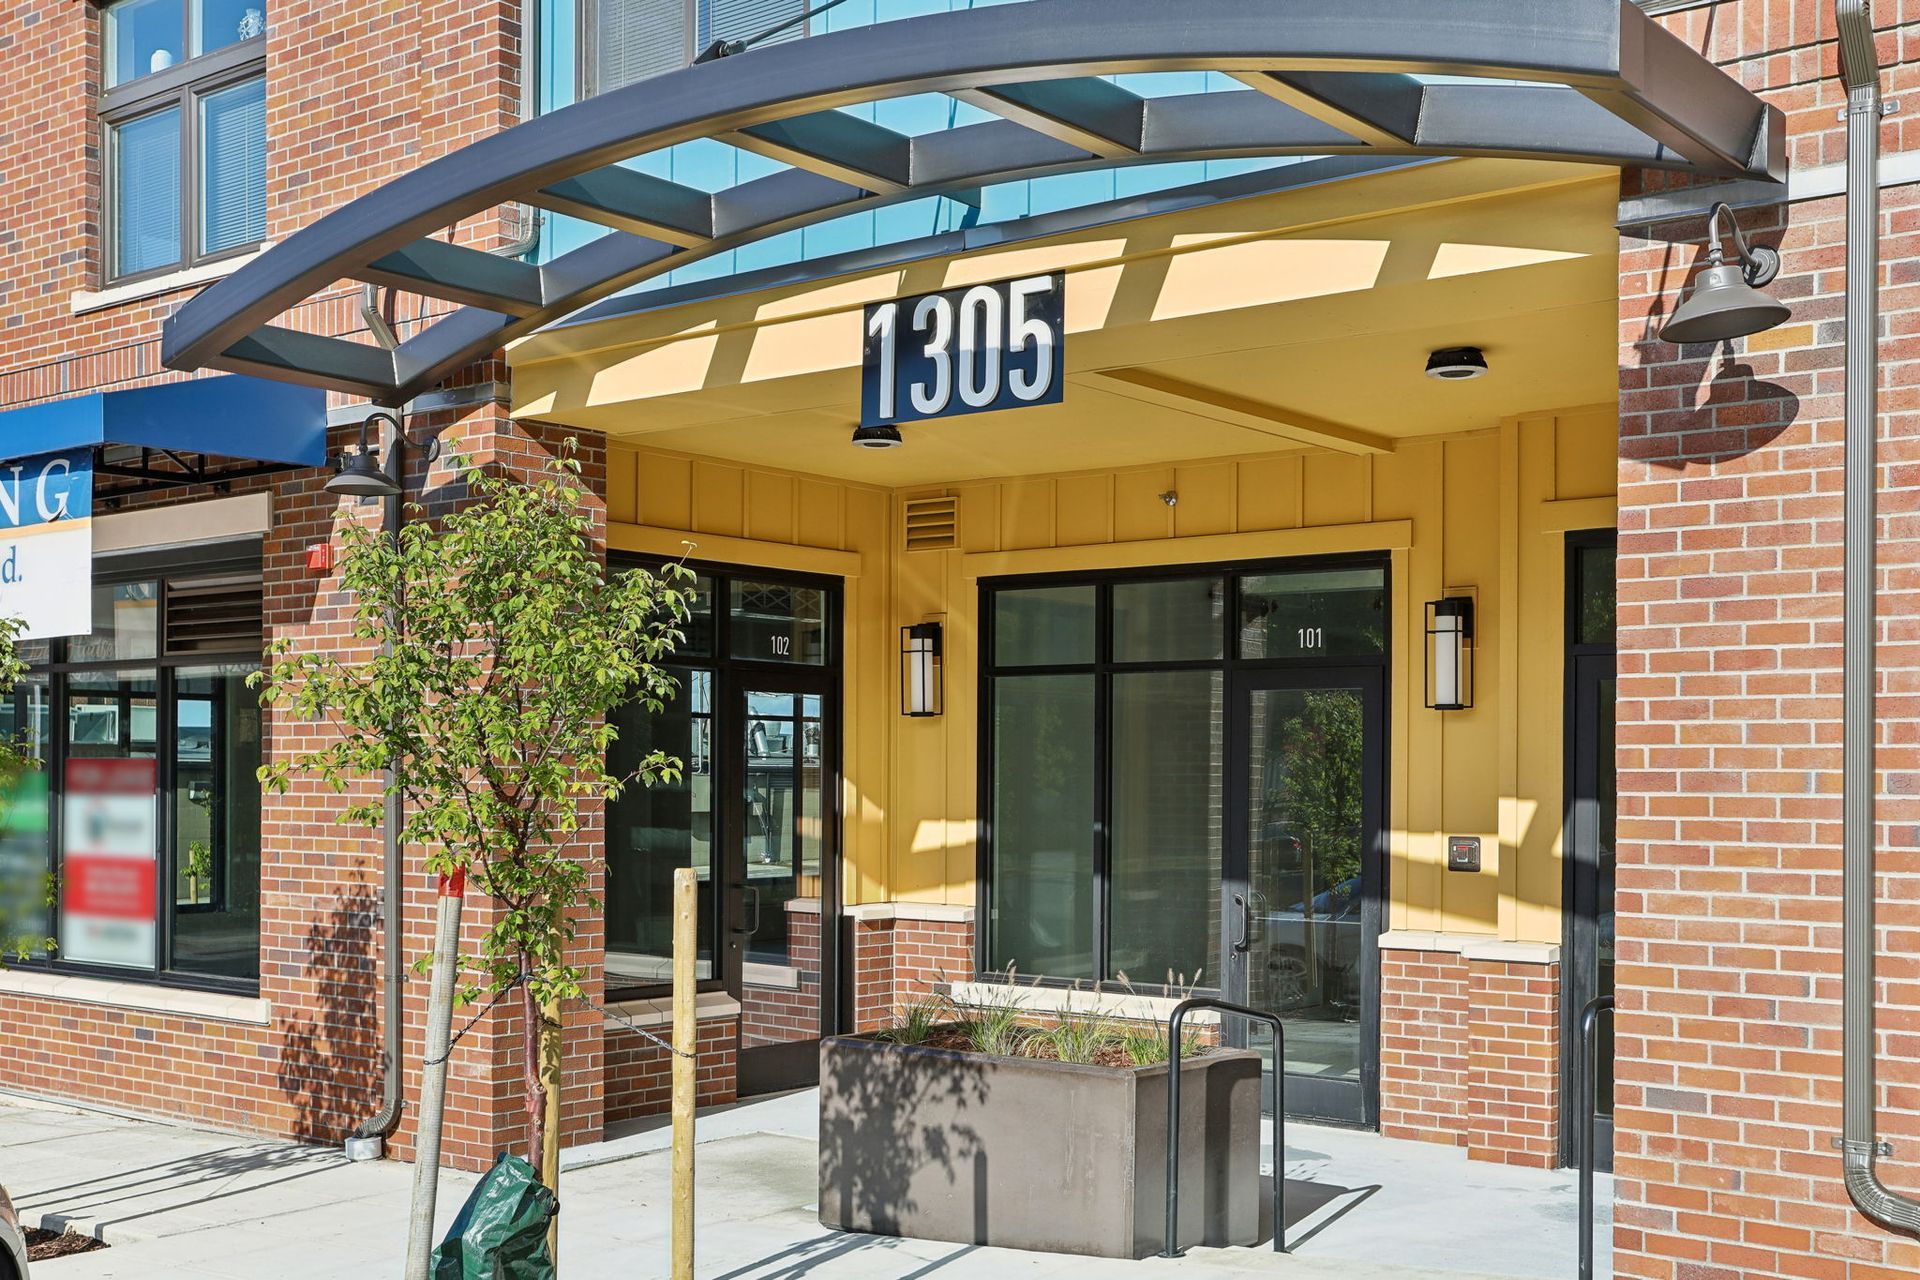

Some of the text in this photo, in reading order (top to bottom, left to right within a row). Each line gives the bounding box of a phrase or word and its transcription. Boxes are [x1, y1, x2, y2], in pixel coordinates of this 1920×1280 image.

[868, 275, 1053, 418] 1305
[770, 635, 790, 656] 102
[1297, 627, 1322, 649] 101
